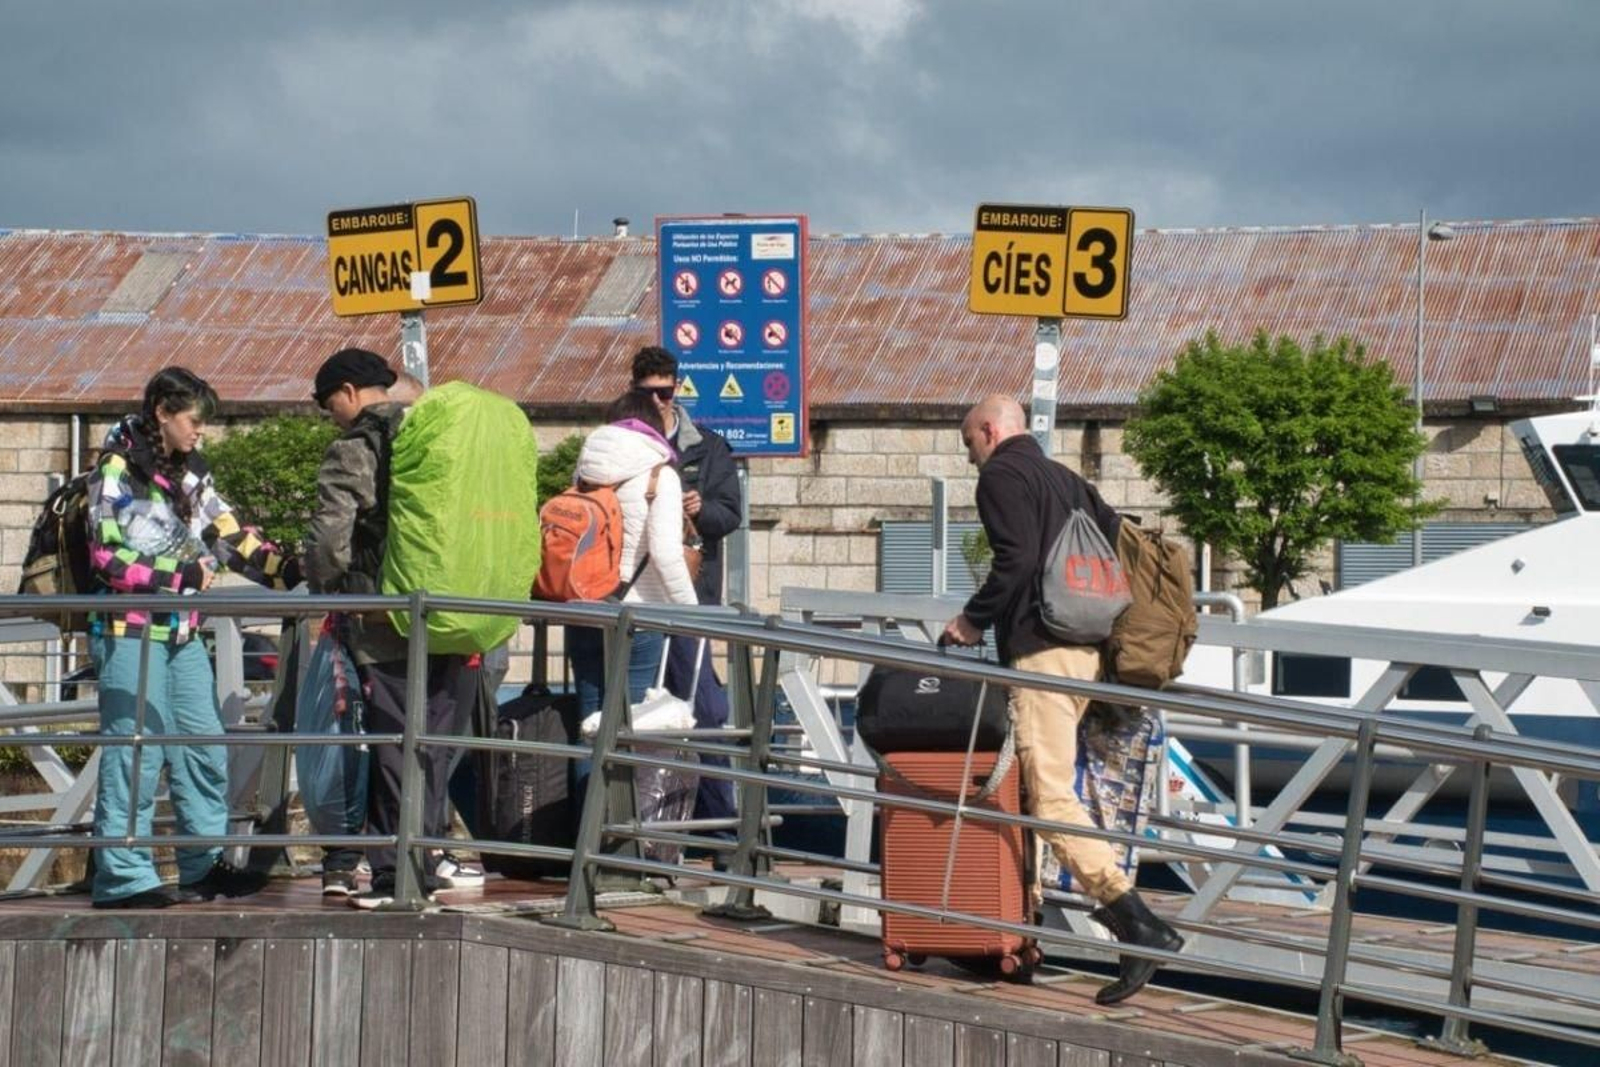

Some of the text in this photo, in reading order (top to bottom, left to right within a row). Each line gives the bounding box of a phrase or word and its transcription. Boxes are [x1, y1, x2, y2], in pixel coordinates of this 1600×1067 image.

[331, 212, 409, 230] EMBARQUE:
[981, 212, 1062, 227] EMBARQUE:
[334, 250, 413, 296] CANGAS
[426, 218, 468, 288] 2
[691, 254, 702, 262] NO
[983, 241, 1051, 296] CÍES
[1073, 227, 1117, 299] 3
